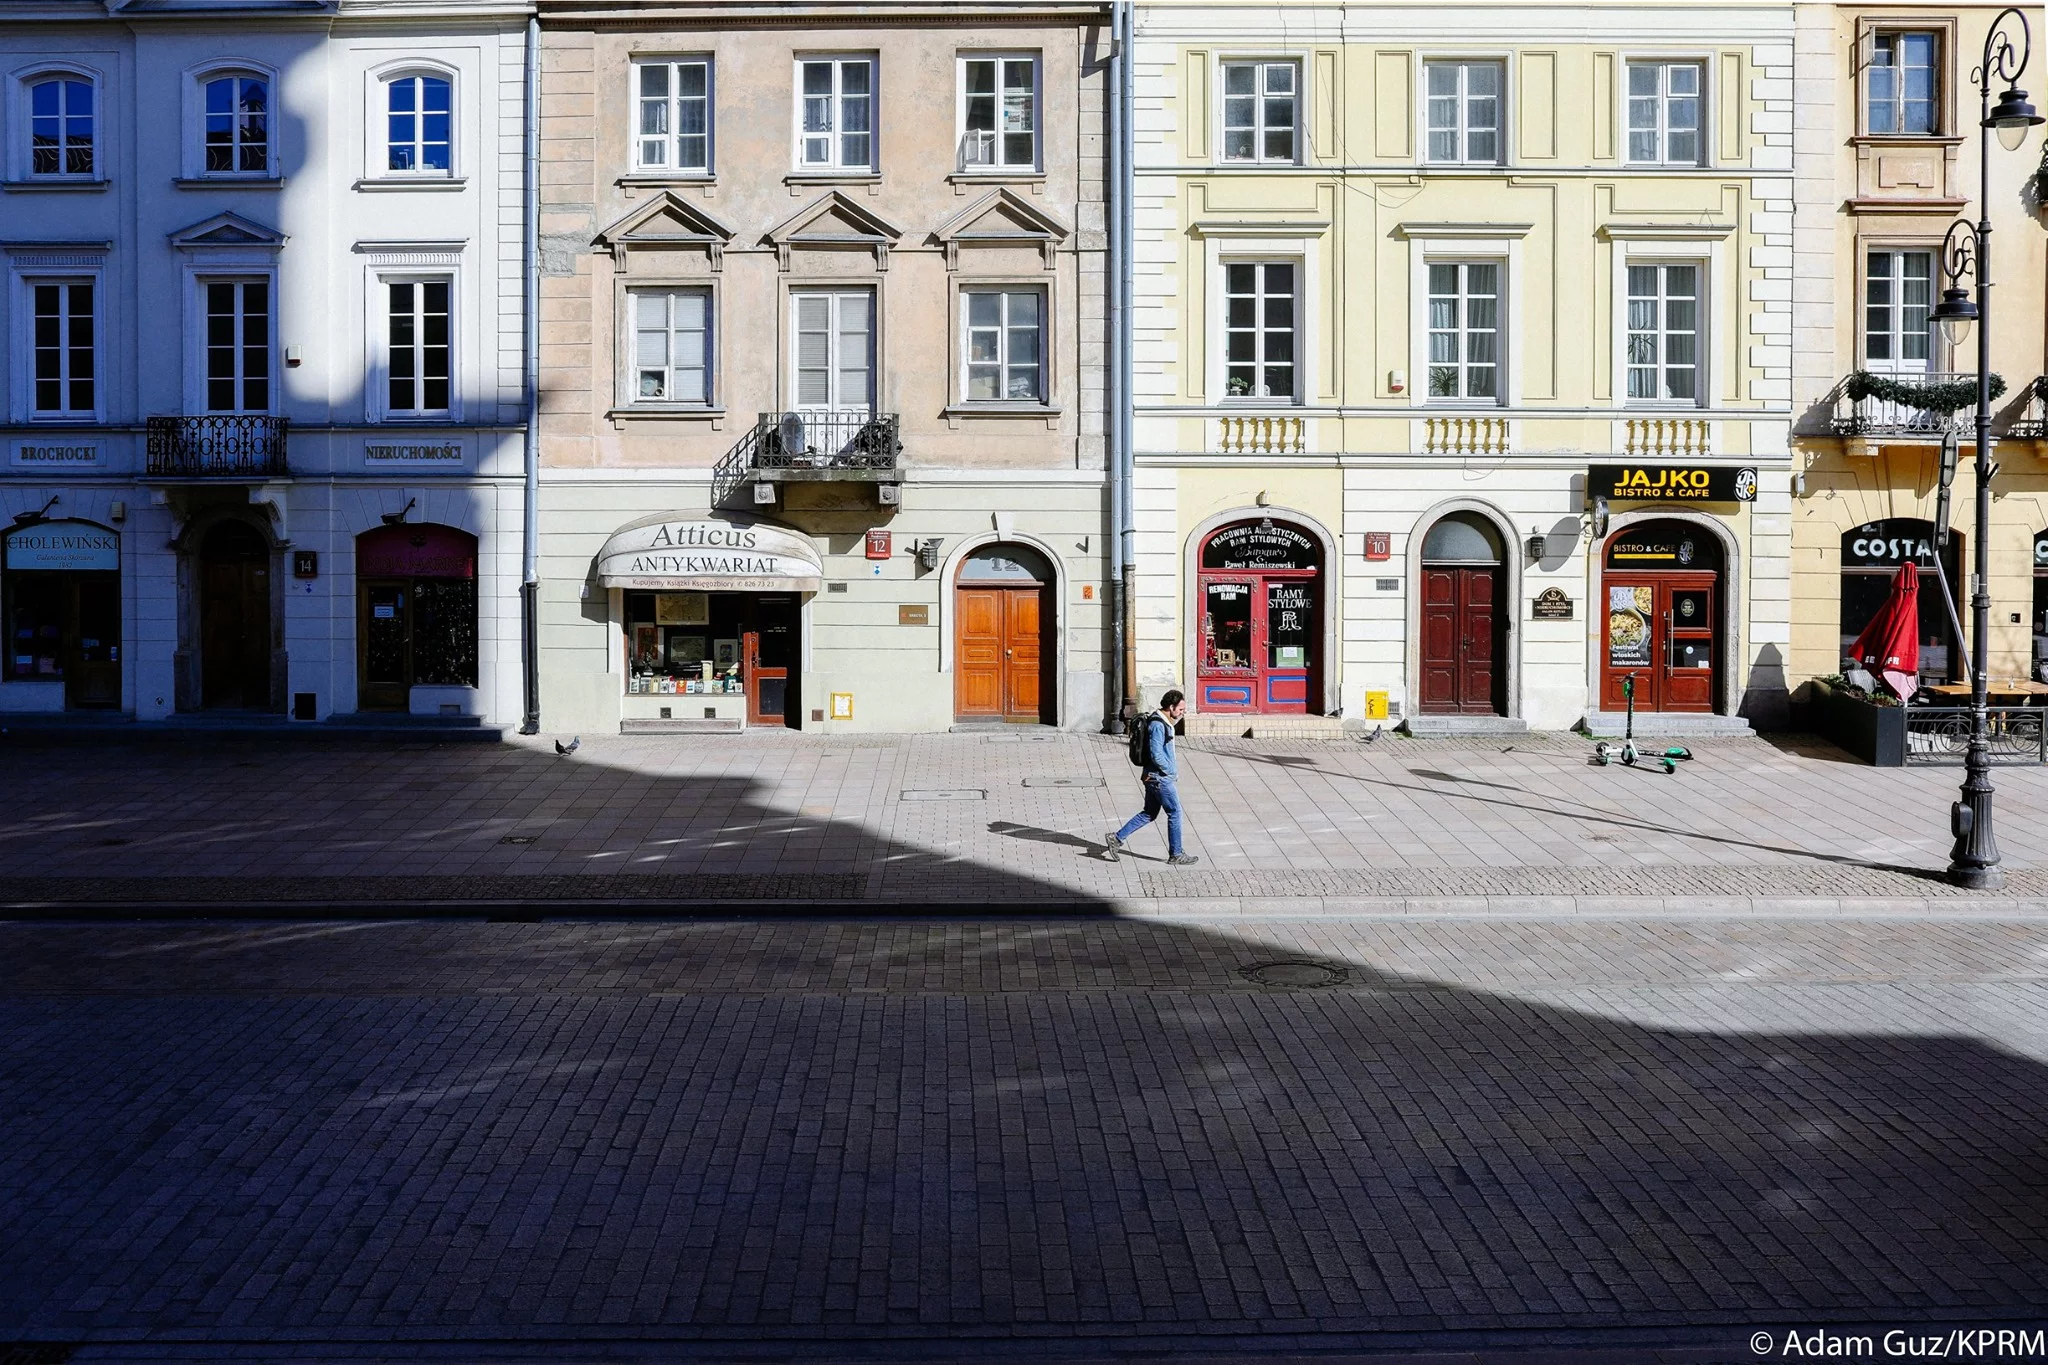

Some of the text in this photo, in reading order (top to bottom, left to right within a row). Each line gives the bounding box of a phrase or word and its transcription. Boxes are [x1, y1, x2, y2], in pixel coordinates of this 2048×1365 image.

[20, 446, 96, 460] BROCHOCKI
[366, 442, 462, 460] NIERUCHOMOŚCI
[1614, 470, 1710, 488] JAJKO
[1614, 488, 1710, 497] BISTRO & CAFE
[7, 533, 119, 550] CHOLEWIŃSKI
[650, 524, 757, 548] Atticus
[1210, 527, 1252, 548] PRACOWNIA
[1230, 535, 1292, 547] RAM STYLOWYCH
[873, 540, 885, 552] 12
[1373, 541, 1385, 553] 10
[1614, 544, 1644, 552] BISTRO
[1853, 538, 1932, 559] COSTA
[299, 560, 312, 572] 14
[631, 556, 778, 572] ANTYKWARIAT
[990, 557, 1019, 571] 12
[632, 578, 734, 588] Kupujemy Książki Księgozbiory
[1208, 585, 1248, 594] RENOWACJA
[1276, 589, 1304, 599] RAMY
[1268, 599, 1312, 608] STYLOWE
